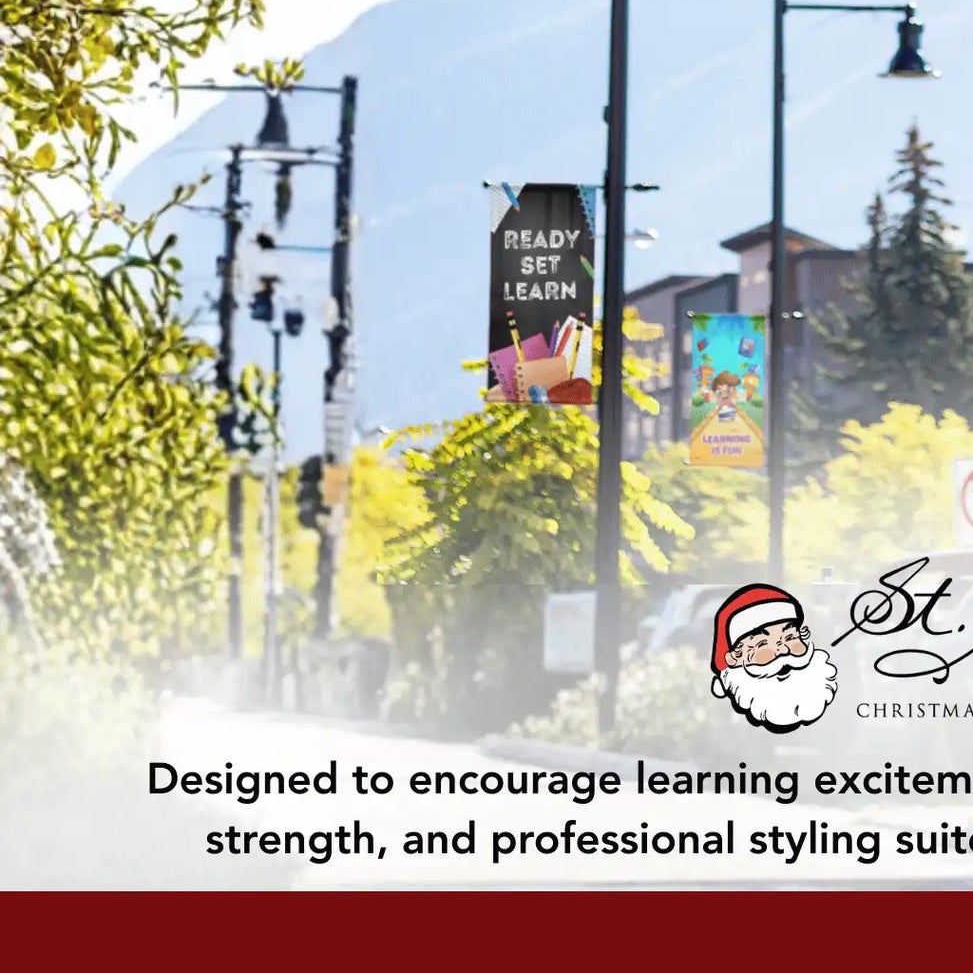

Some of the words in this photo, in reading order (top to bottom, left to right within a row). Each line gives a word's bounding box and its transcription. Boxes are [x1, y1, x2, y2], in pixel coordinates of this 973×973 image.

[504, 230, 580, 249] READY
[520, 255, 561, 275] SET
[503, 281, 577, 300] LEARN
[702, 434, 752, 444] LEARNING
[722, 446, 744, 455] FUN
